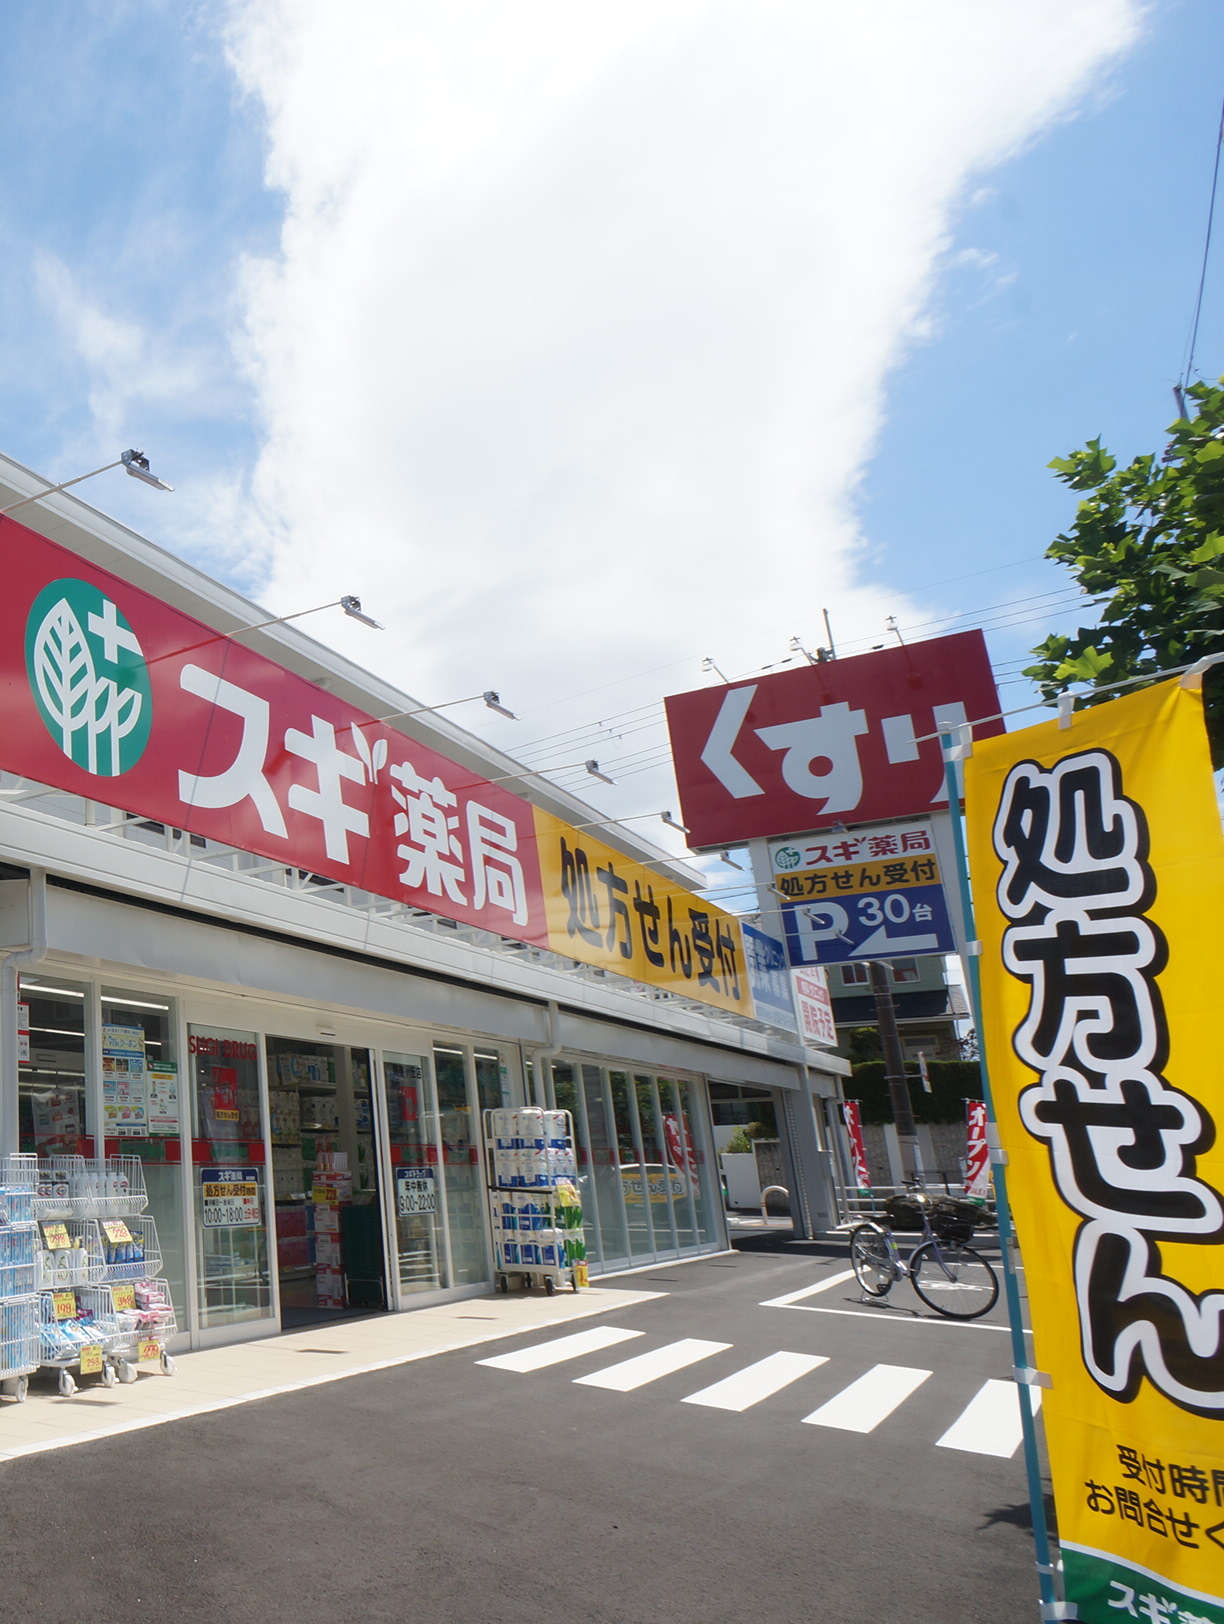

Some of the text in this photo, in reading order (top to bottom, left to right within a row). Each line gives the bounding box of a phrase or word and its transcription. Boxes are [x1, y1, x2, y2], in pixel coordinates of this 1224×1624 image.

[700, 683, 972, 816] くすり
[178, 663, 528, 926] スギ薬局
[780, 858, 937, 897] 処方せん受付
[804, 830, 932, 866] スギ薬局
[560, 836, 742, 1002] 処方せん受付
[188, 1034, 257, 1061] SUGI DRUG
[992, 748, 1224, 1420] 処方せん
[56, 1303, 72, 1314] 198
